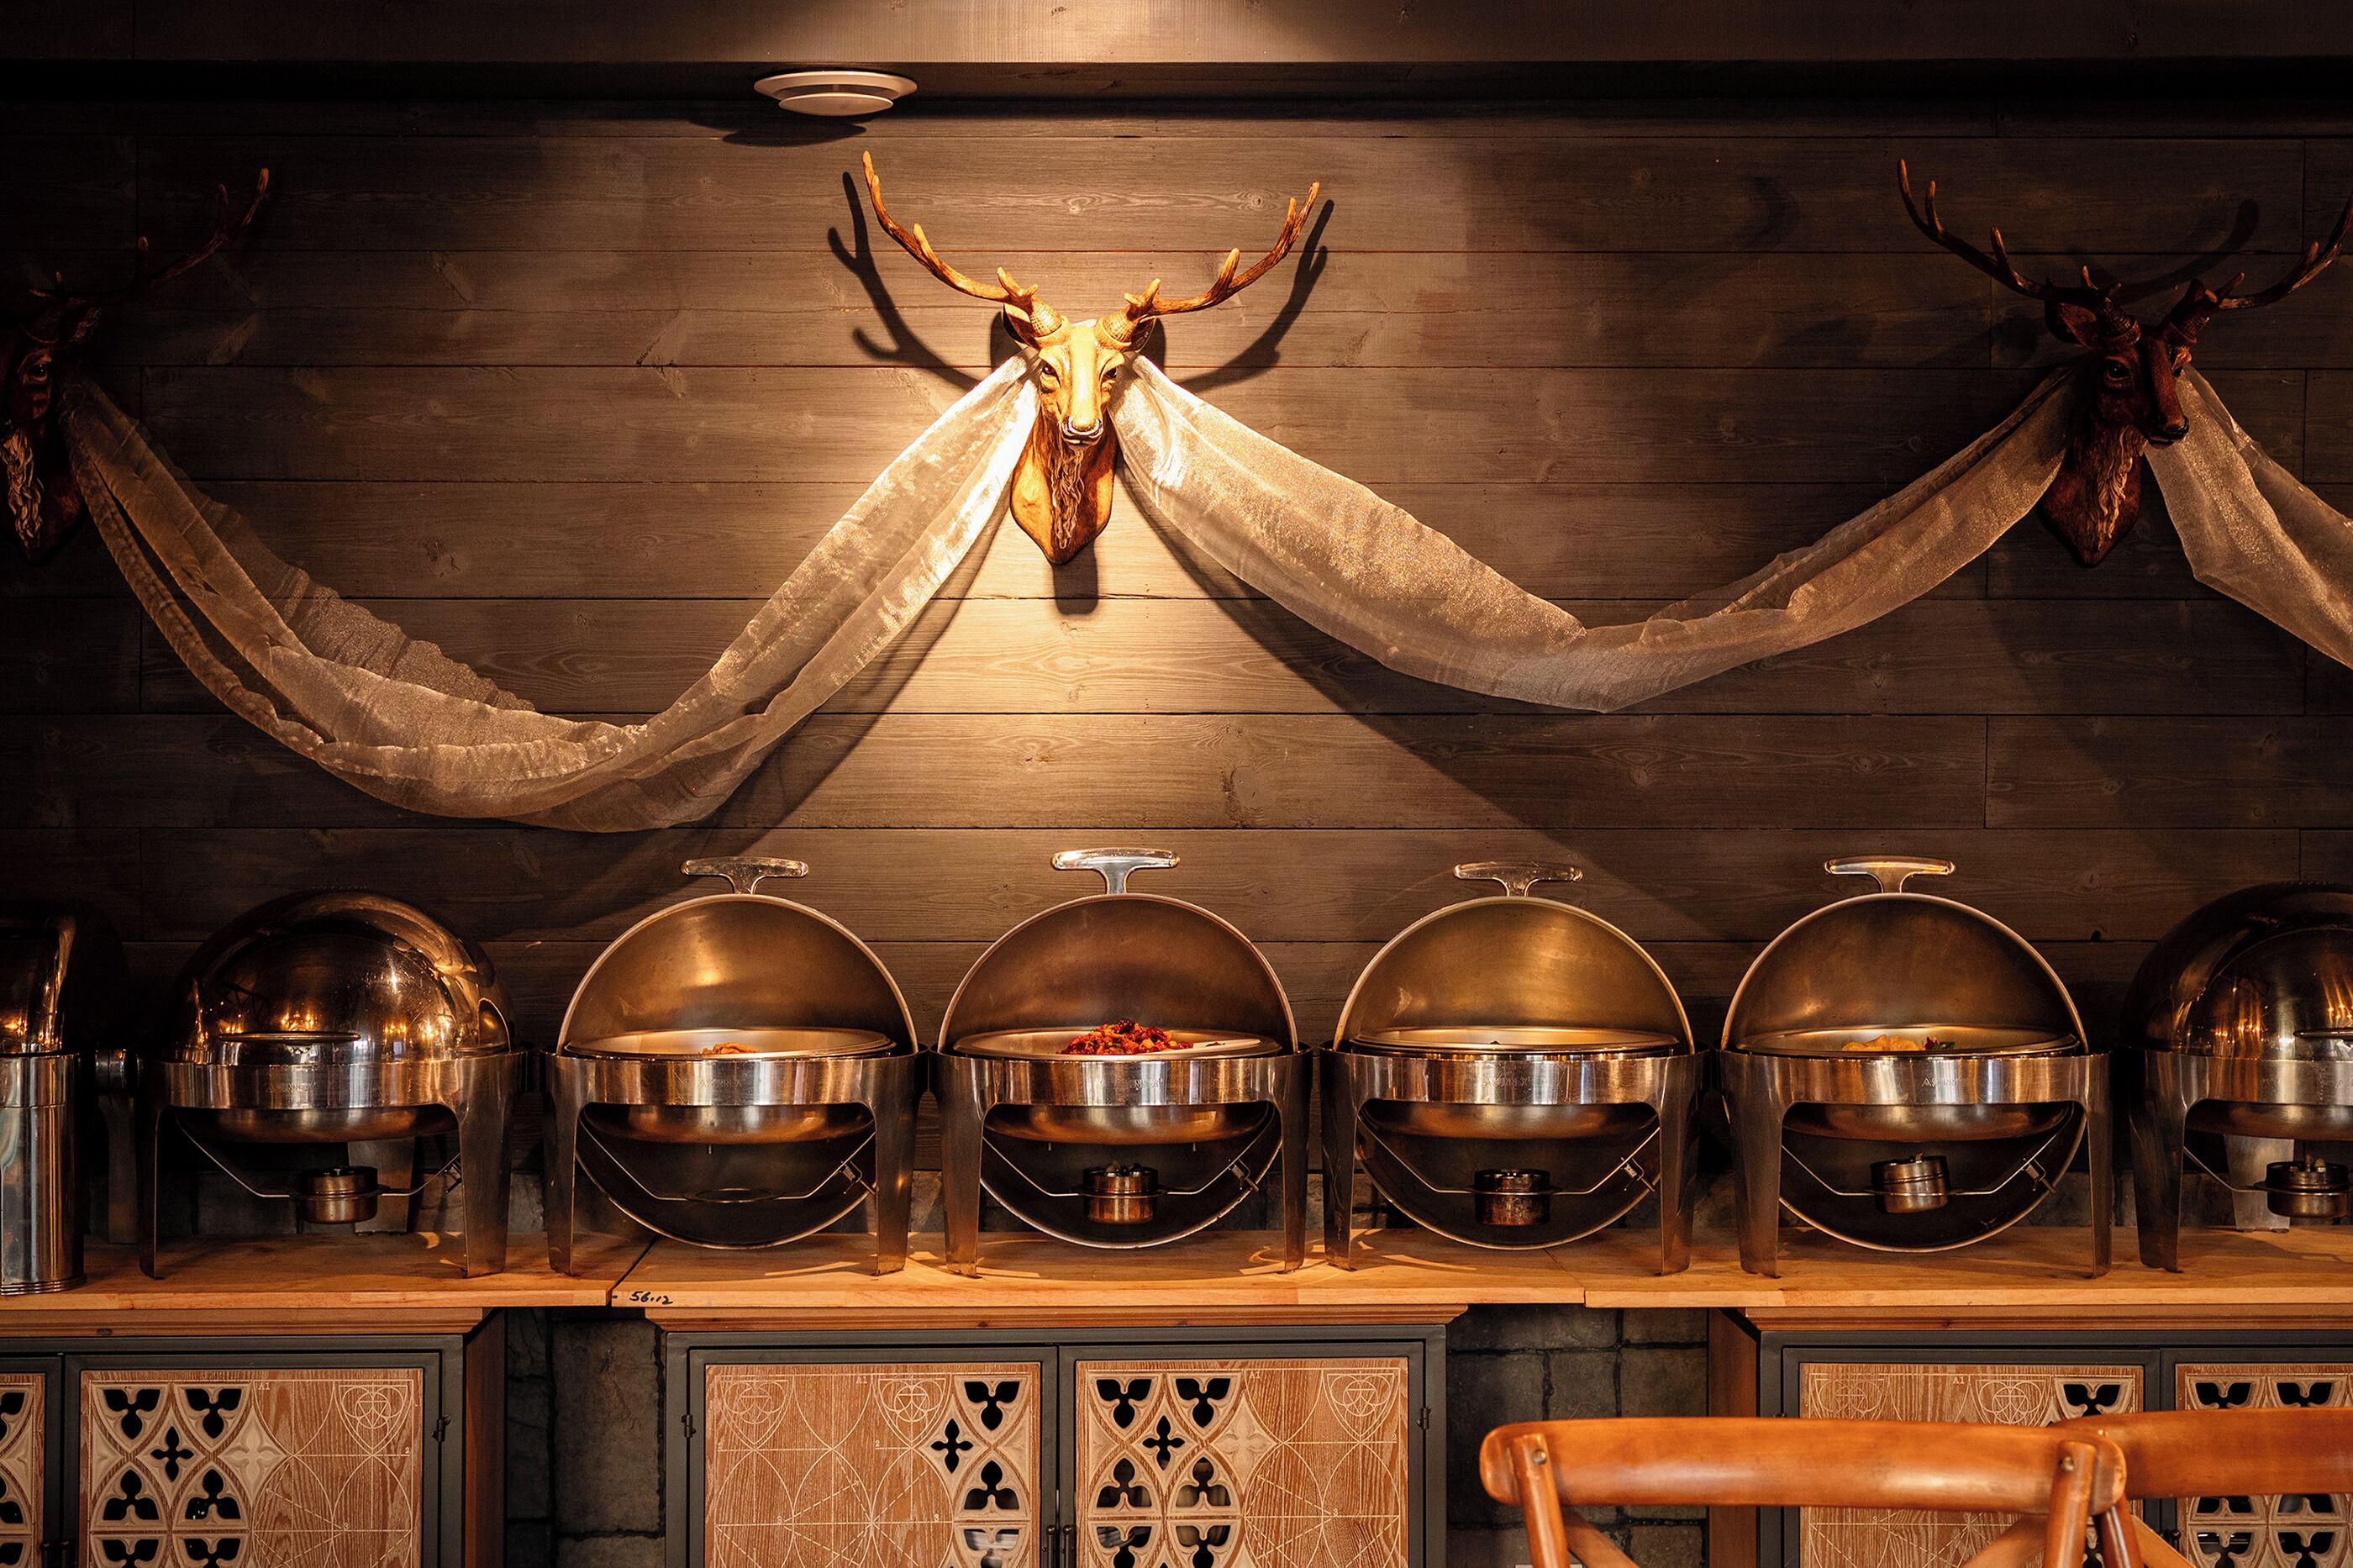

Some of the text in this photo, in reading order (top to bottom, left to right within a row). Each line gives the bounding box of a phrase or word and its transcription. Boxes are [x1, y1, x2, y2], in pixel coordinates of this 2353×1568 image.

[1249, 1371, 1261, 1379] A1
[855, 1376, 868, 1384] A1
[1952, 1376, 1965, 1385] A1
[258, 1382, 271, 1391] A1
[1392, 1434, 1398, 1442] 2
